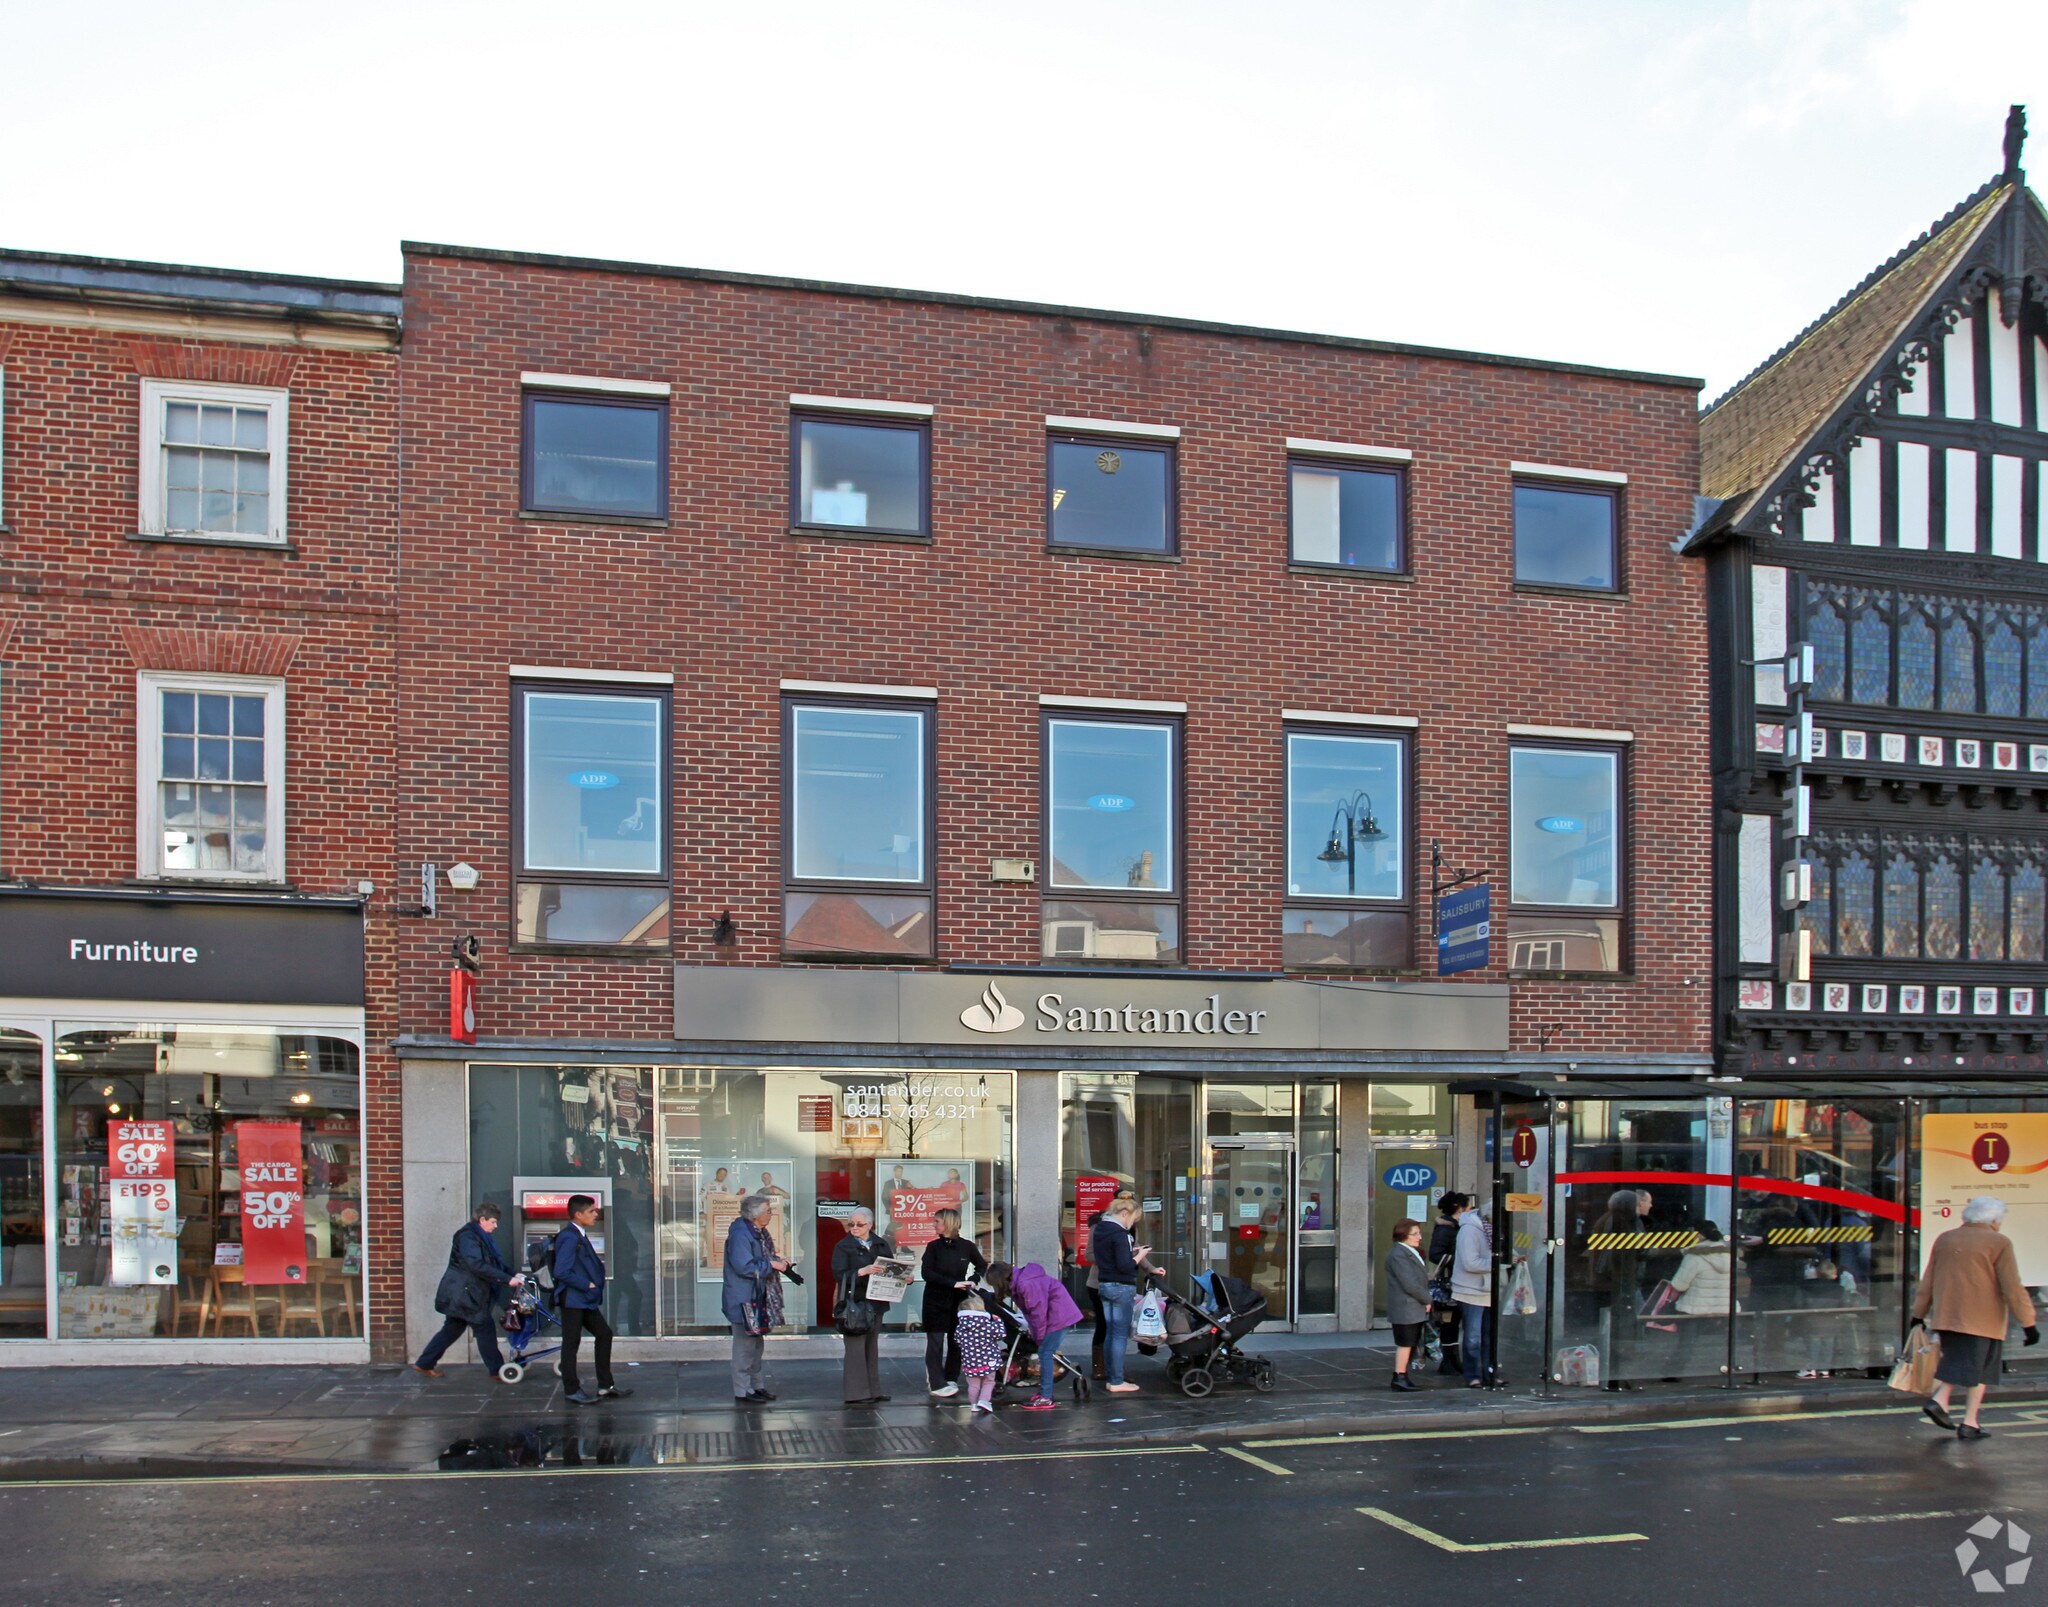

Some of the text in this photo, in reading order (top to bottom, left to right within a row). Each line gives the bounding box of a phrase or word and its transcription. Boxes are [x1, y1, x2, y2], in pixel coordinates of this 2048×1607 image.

[579, 774, 607, 785] ADP
[1099, 797, 1124, 808] ADP
[1552, 820, 1574, 830] ADP
[1441, 898, 1487, 921] SALISBURY
[69, 938, 198, 964] Furniture
[1036, 993, 1267, 1034] Santander
[846, 1082, 990, 1098] santander.co.uk
[847, 1104, 892, 1119] 0845
[899, 1104, 929, 1119] 765
[935, 1104, 976, 1119] 4321
[324, 1123, 351, 1131] SALE
[1990, 1122, 2008, 1130] stop
[118, 1128, 165, 1140] SALE
[1519, 1132, 1530, 1156] T
[1983, 1138, 1998, 1158] T
[117, 1143, 167, 1163] 60%
[125, 1162, 160, 1175] OFF
[245, 1168, 297, 1182] SALE
[1391, 1168, 1431, 1186] ADP
[120, 1183, 166, 1197] £199
[244, 1191, 300, 1215] 50%
[894, 1194, 927, 1212] 3%
[253, 1214, 292, 1229] OFF
